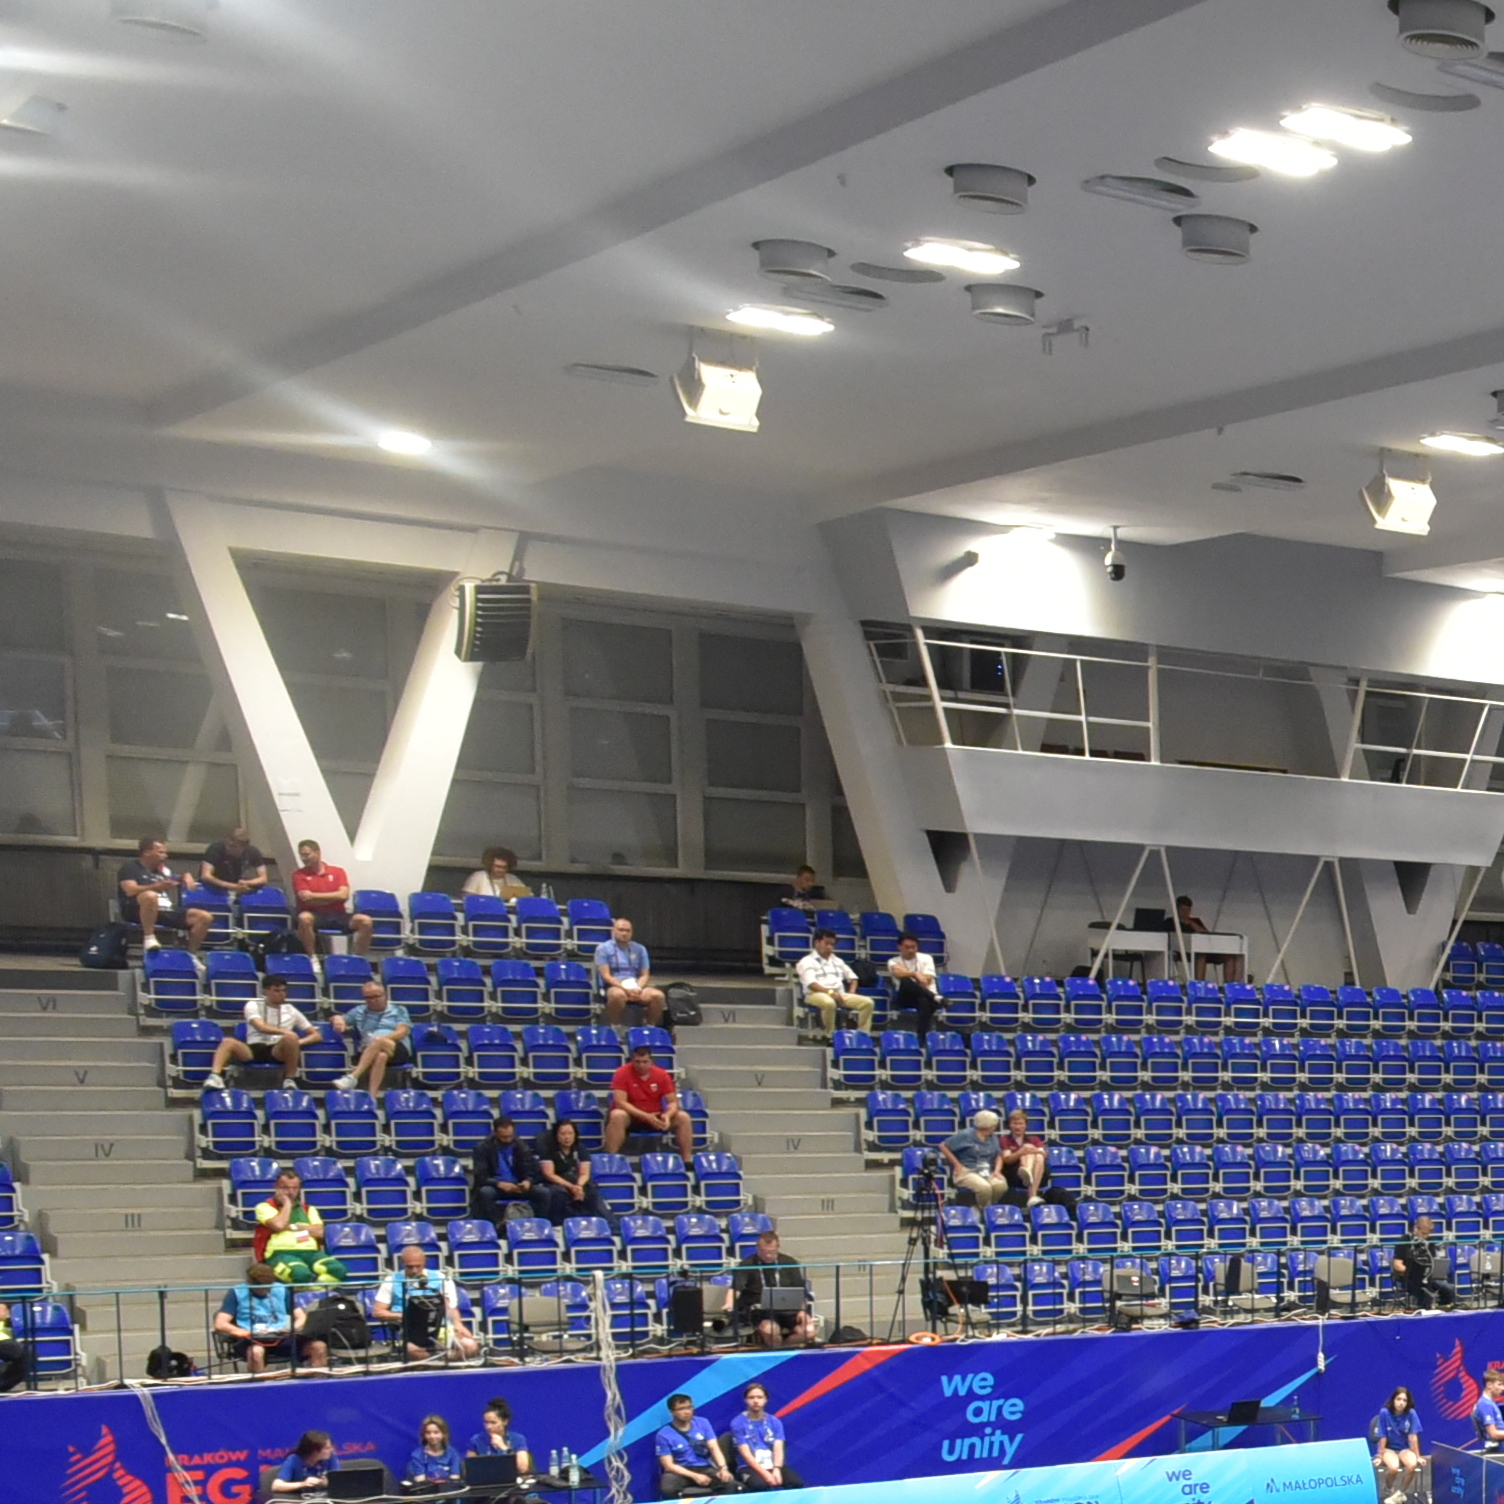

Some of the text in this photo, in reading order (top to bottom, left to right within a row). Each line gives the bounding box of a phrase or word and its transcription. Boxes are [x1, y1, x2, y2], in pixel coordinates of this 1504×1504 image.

[74, 1069, 88, 1085] V
[94, 1142, 114, 1158] IV
[941, 1372, 994, 1397] we
[966, 1397, 1025, 1424] are
[941, 1427, 1024, 1465] unity
[1166, 1469, 1192, 1483] we
[1283, 1474, 1364, 1492] MAŁOPOLSKA
[1181, 1481, 1210, 1496] are
